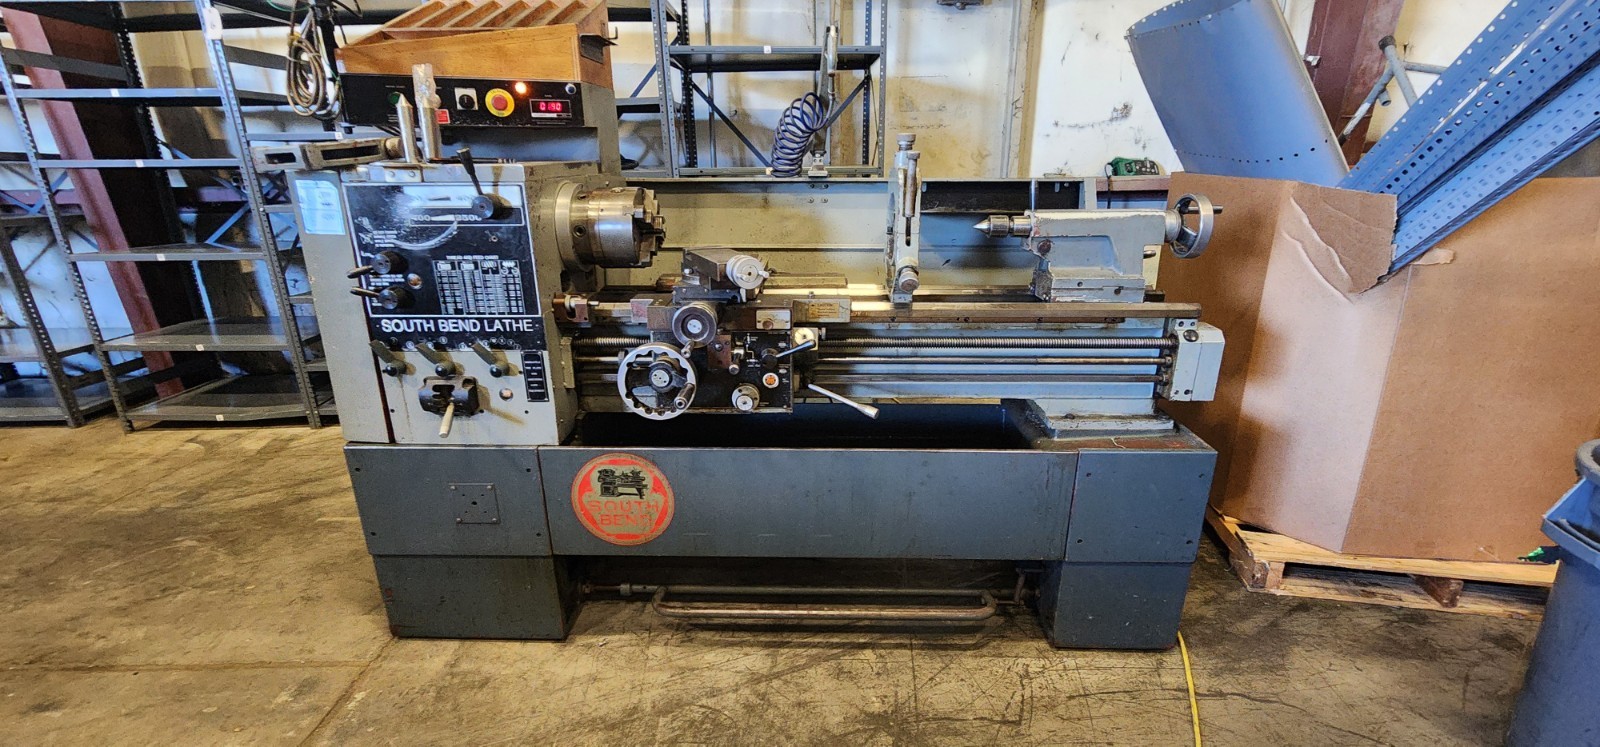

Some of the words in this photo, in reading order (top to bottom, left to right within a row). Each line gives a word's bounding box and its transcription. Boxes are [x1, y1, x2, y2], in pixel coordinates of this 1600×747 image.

[381, 318, 435, 333] SOUTH
[438, 318, 481, 333] BEND
[484, 319, 533, 332] LATHE
[588, 499, 660, 513] SOUTH
